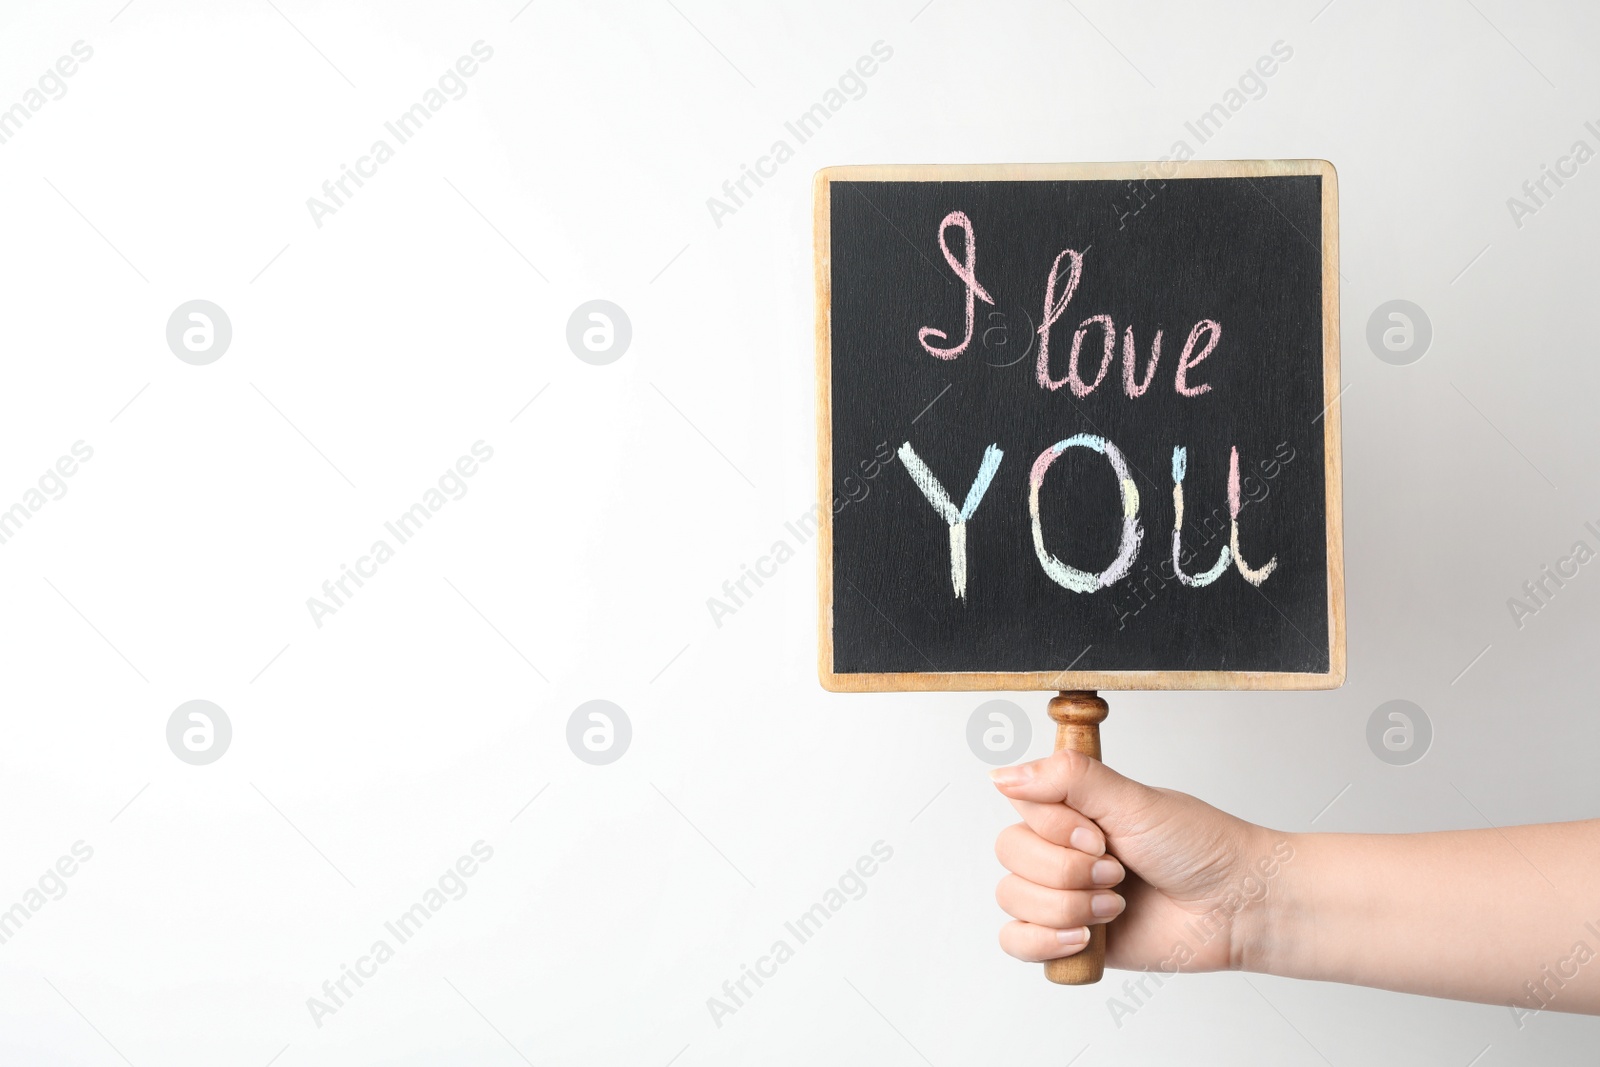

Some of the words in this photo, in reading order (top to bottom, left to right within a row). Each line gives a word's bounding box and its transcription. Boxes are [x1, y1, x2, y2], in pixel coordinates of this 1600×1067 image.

[918, 211, 994, 360] I
[1036, 248, 1222, 399] love
[898, 433, 1277, 602] YOU
